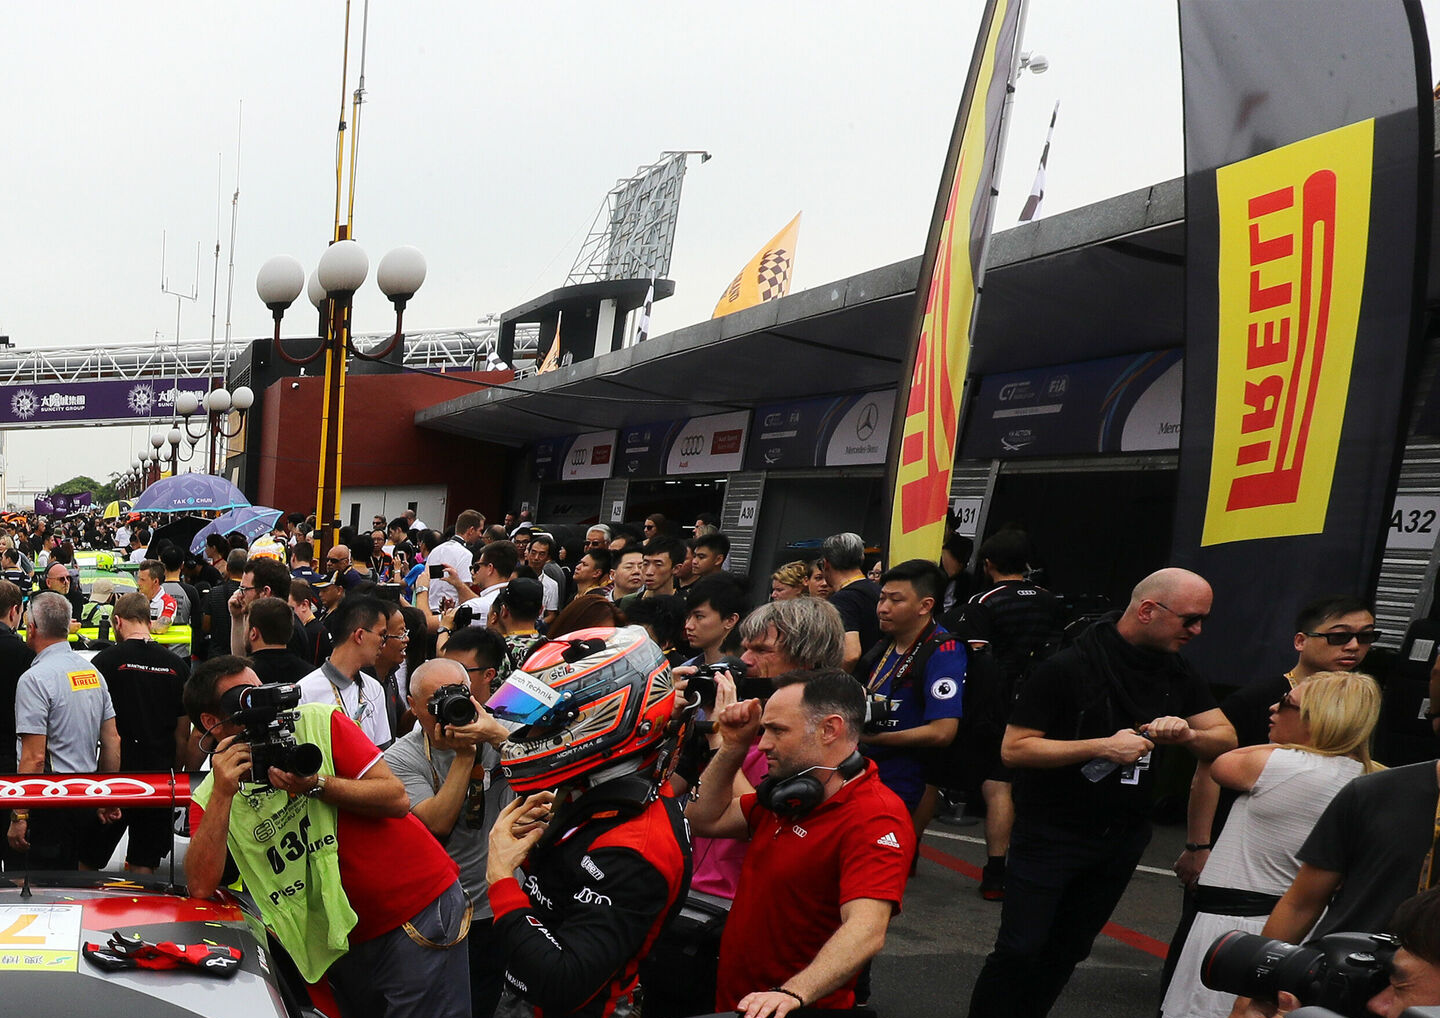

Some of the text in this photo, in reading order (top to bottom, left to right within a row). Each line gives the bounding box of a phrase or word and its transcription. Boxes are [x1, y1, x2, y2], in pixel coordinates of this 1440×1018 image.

[1225, 169, 1337, 512] PIRELLI
[741, 506, 755, 519] A30
[1389, 509, 1437, 533] A32
[71, 673, 99, 687] PIRELLI
[525, 678, 553, 702] Technik
[556, 741, 594, 759] MORTARA
[524, 875, 554, 911] Sport
